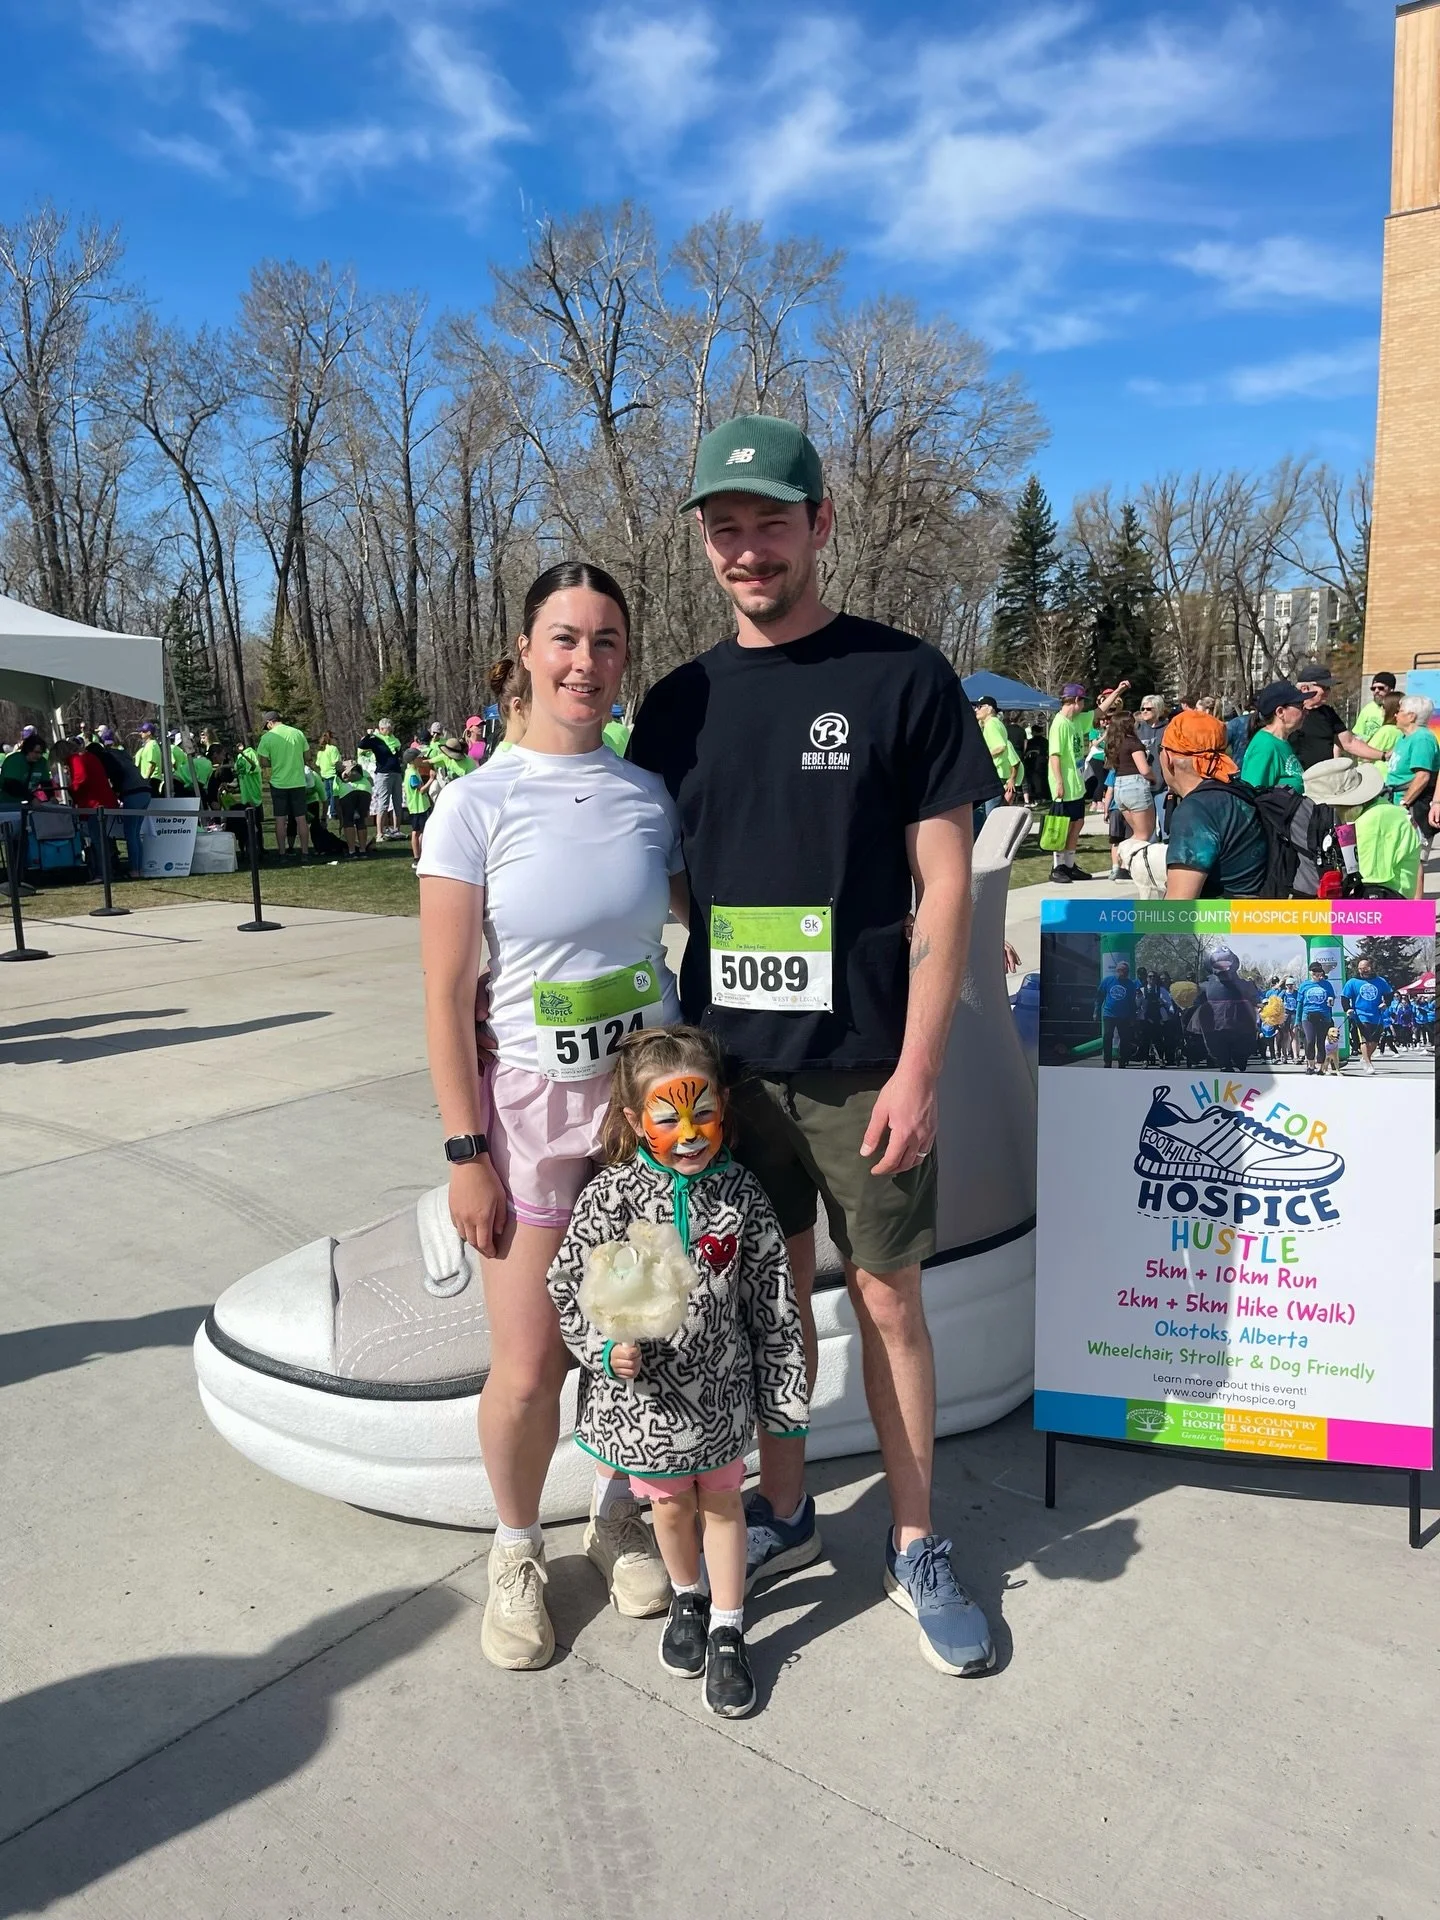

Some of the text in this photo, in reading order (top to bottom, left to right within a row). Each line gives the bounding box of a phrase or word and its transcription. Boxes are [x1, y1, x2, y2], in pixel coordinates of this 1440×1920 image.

[802, 752, 850, 765] REBEL BEAN
[156, 828, 191, 836] gistration
[172, 817, 186, 825] Day
[1099, 911, 1382, 924] A FOOTHILLS COUNTRY HOSPICE FUNDRAISER
[721, 954, 809, 992] 5089
[540, 1007, 573, 1017] HOSPICE
[1190, 1079, 1327, 1148] HIKE FOR
[1141, 1128, 1203, 1163] FOOTHILLS
[1137, 1180, 1340, 1226] HOSPICE
[1171, 1220, 1299, 1263] HUSTLE
[1145, 1258, 1317, 1289] 5km + 10km Run
[1117, 1287, 1355, 1325] 2km + 5km Hike (Walk)
[1155, 1319, 1308, 1349] Okotoks, Alberta
[1087, 1340, 1375, 1384] Wheelchair, Stroller & Dog Friendly
[1153, 1373, 1307, 1396] Learn more about this event!
[1163, 1387, 1296, 1410] www.countryhospice.org
[1182, 1409, 1317, 1431] FOOTHILLS COUNTRY
[1182, 1419, 1295, 1438] HOSPICE SOCIETY
[1181, 1431, 1207, 1441] Gentle
